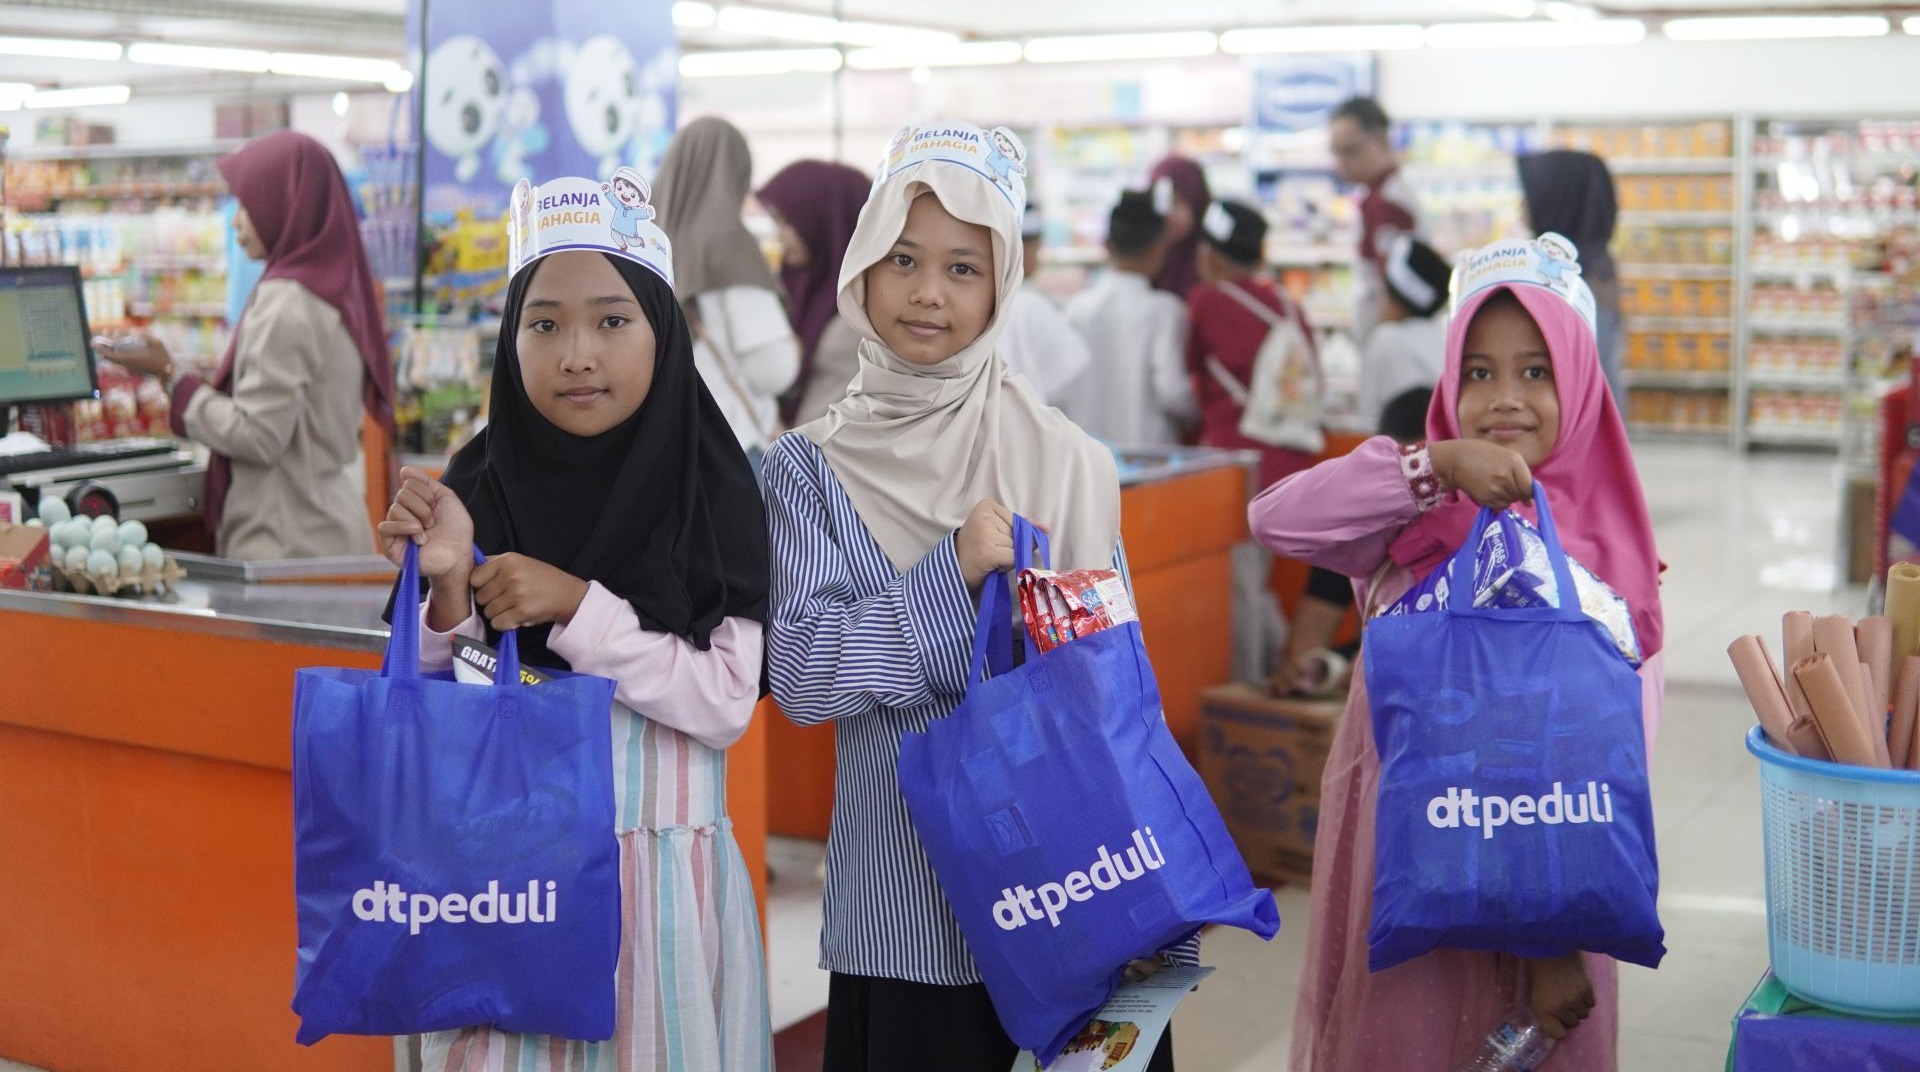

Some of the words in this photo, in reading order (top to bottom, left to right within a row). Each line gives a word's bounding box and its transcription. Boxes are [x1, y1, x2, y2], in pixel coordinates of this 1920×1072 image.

[914, 129, 979, 143] BELANJA
[537, 193, 600, 212] BELANJA
[1426, 781, 1614, 840] dtpeduli
[992, 826, 1166, 931] dtpeduli
[352, 879, 557, 936] dtpeduli
